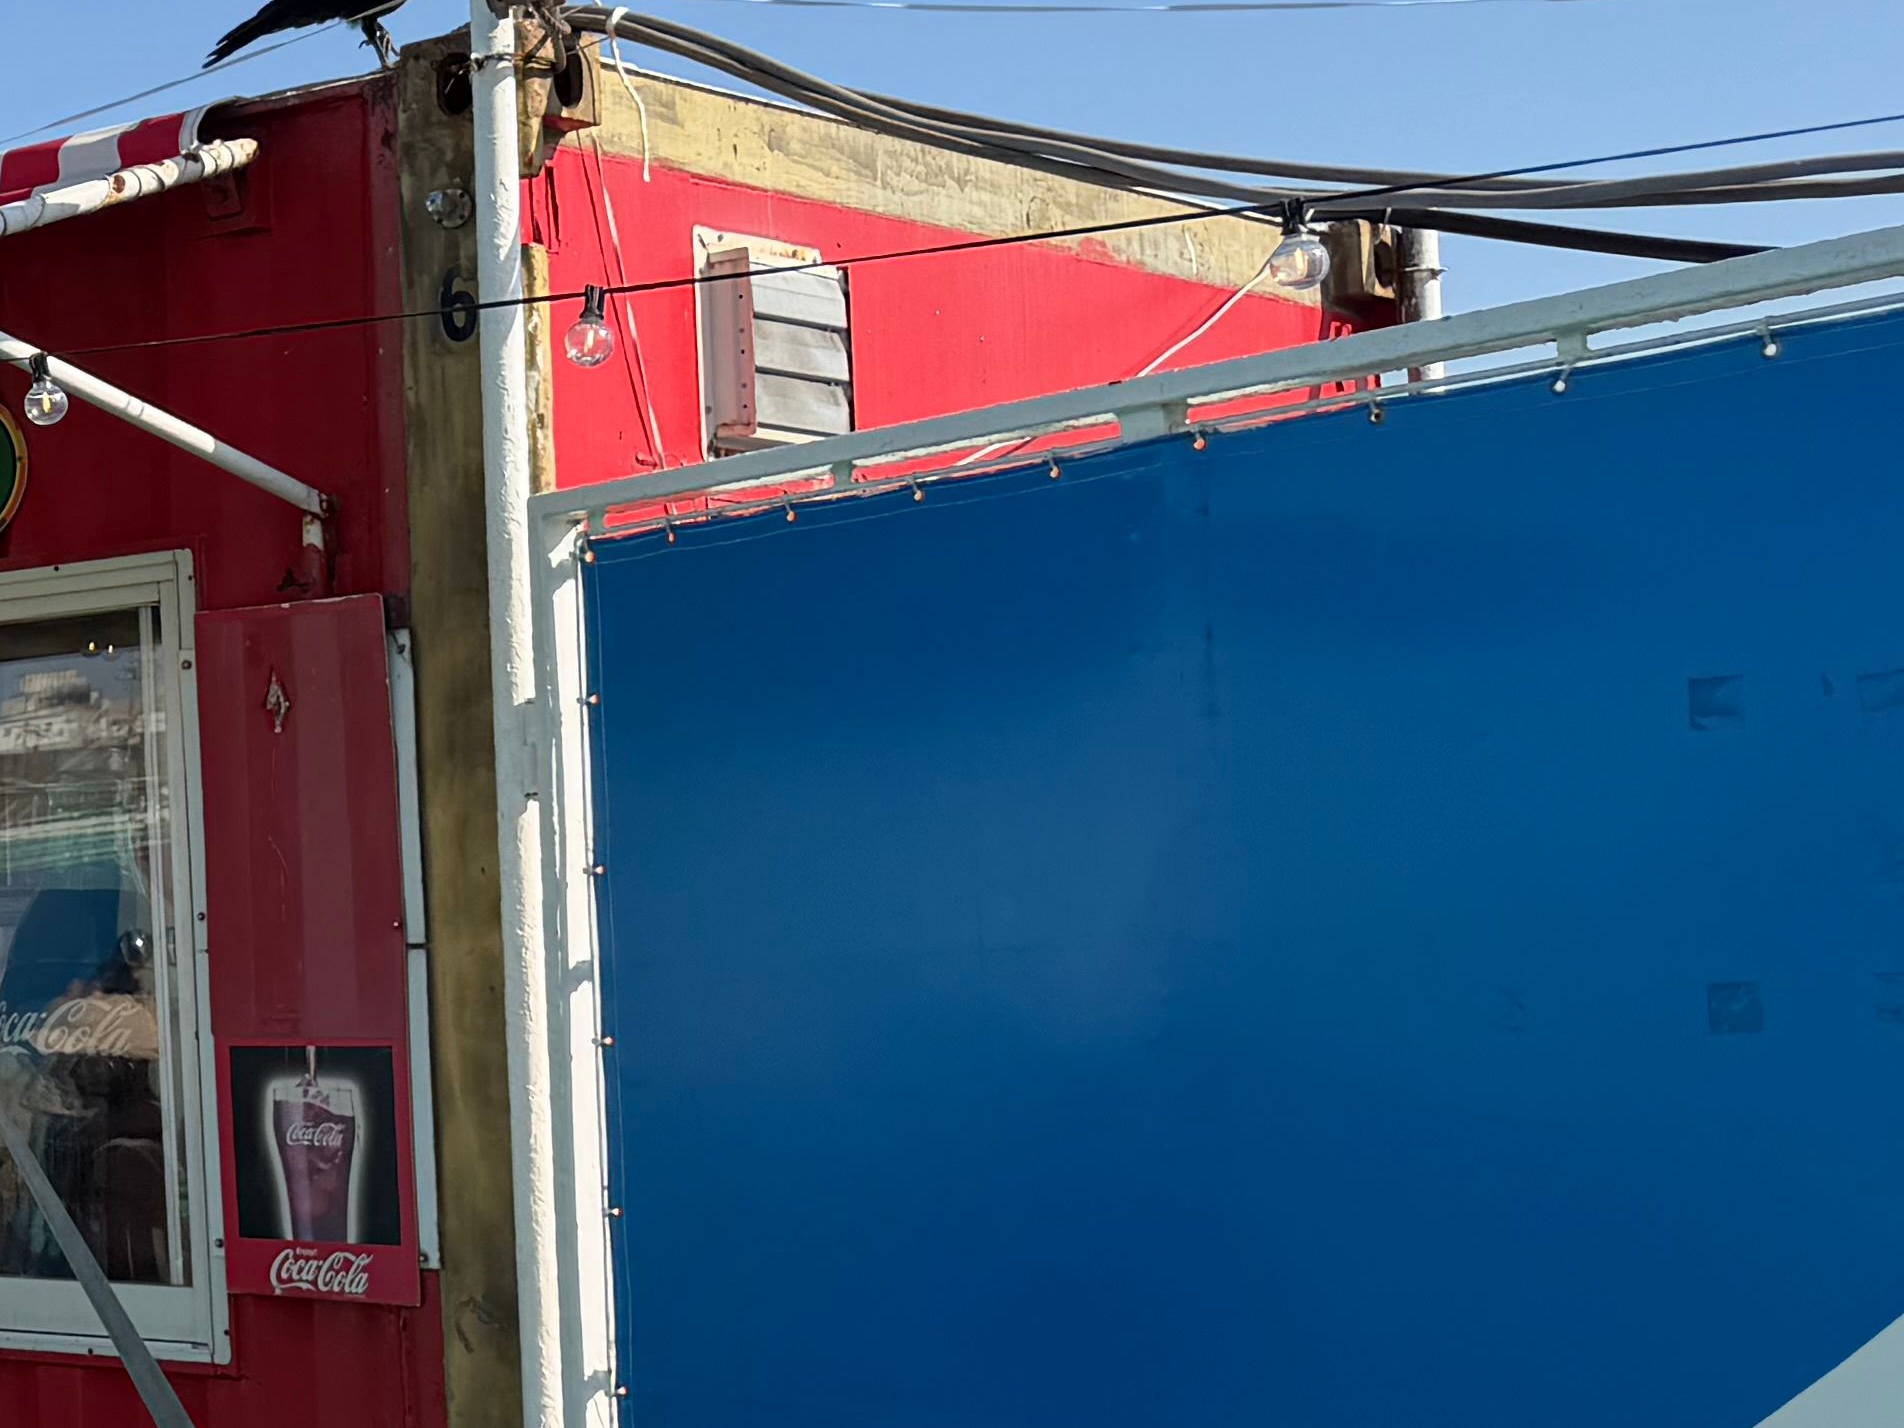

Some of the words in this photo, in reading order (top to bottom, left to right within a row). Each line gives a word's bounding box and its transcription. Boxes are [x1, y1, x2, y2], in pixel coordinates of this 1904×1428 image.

[441, 264, 477, 342] 6
[287, 1123, 345, 1147] Coca-Cola
[271, 1249, 373, 1295] Coca-Cola
